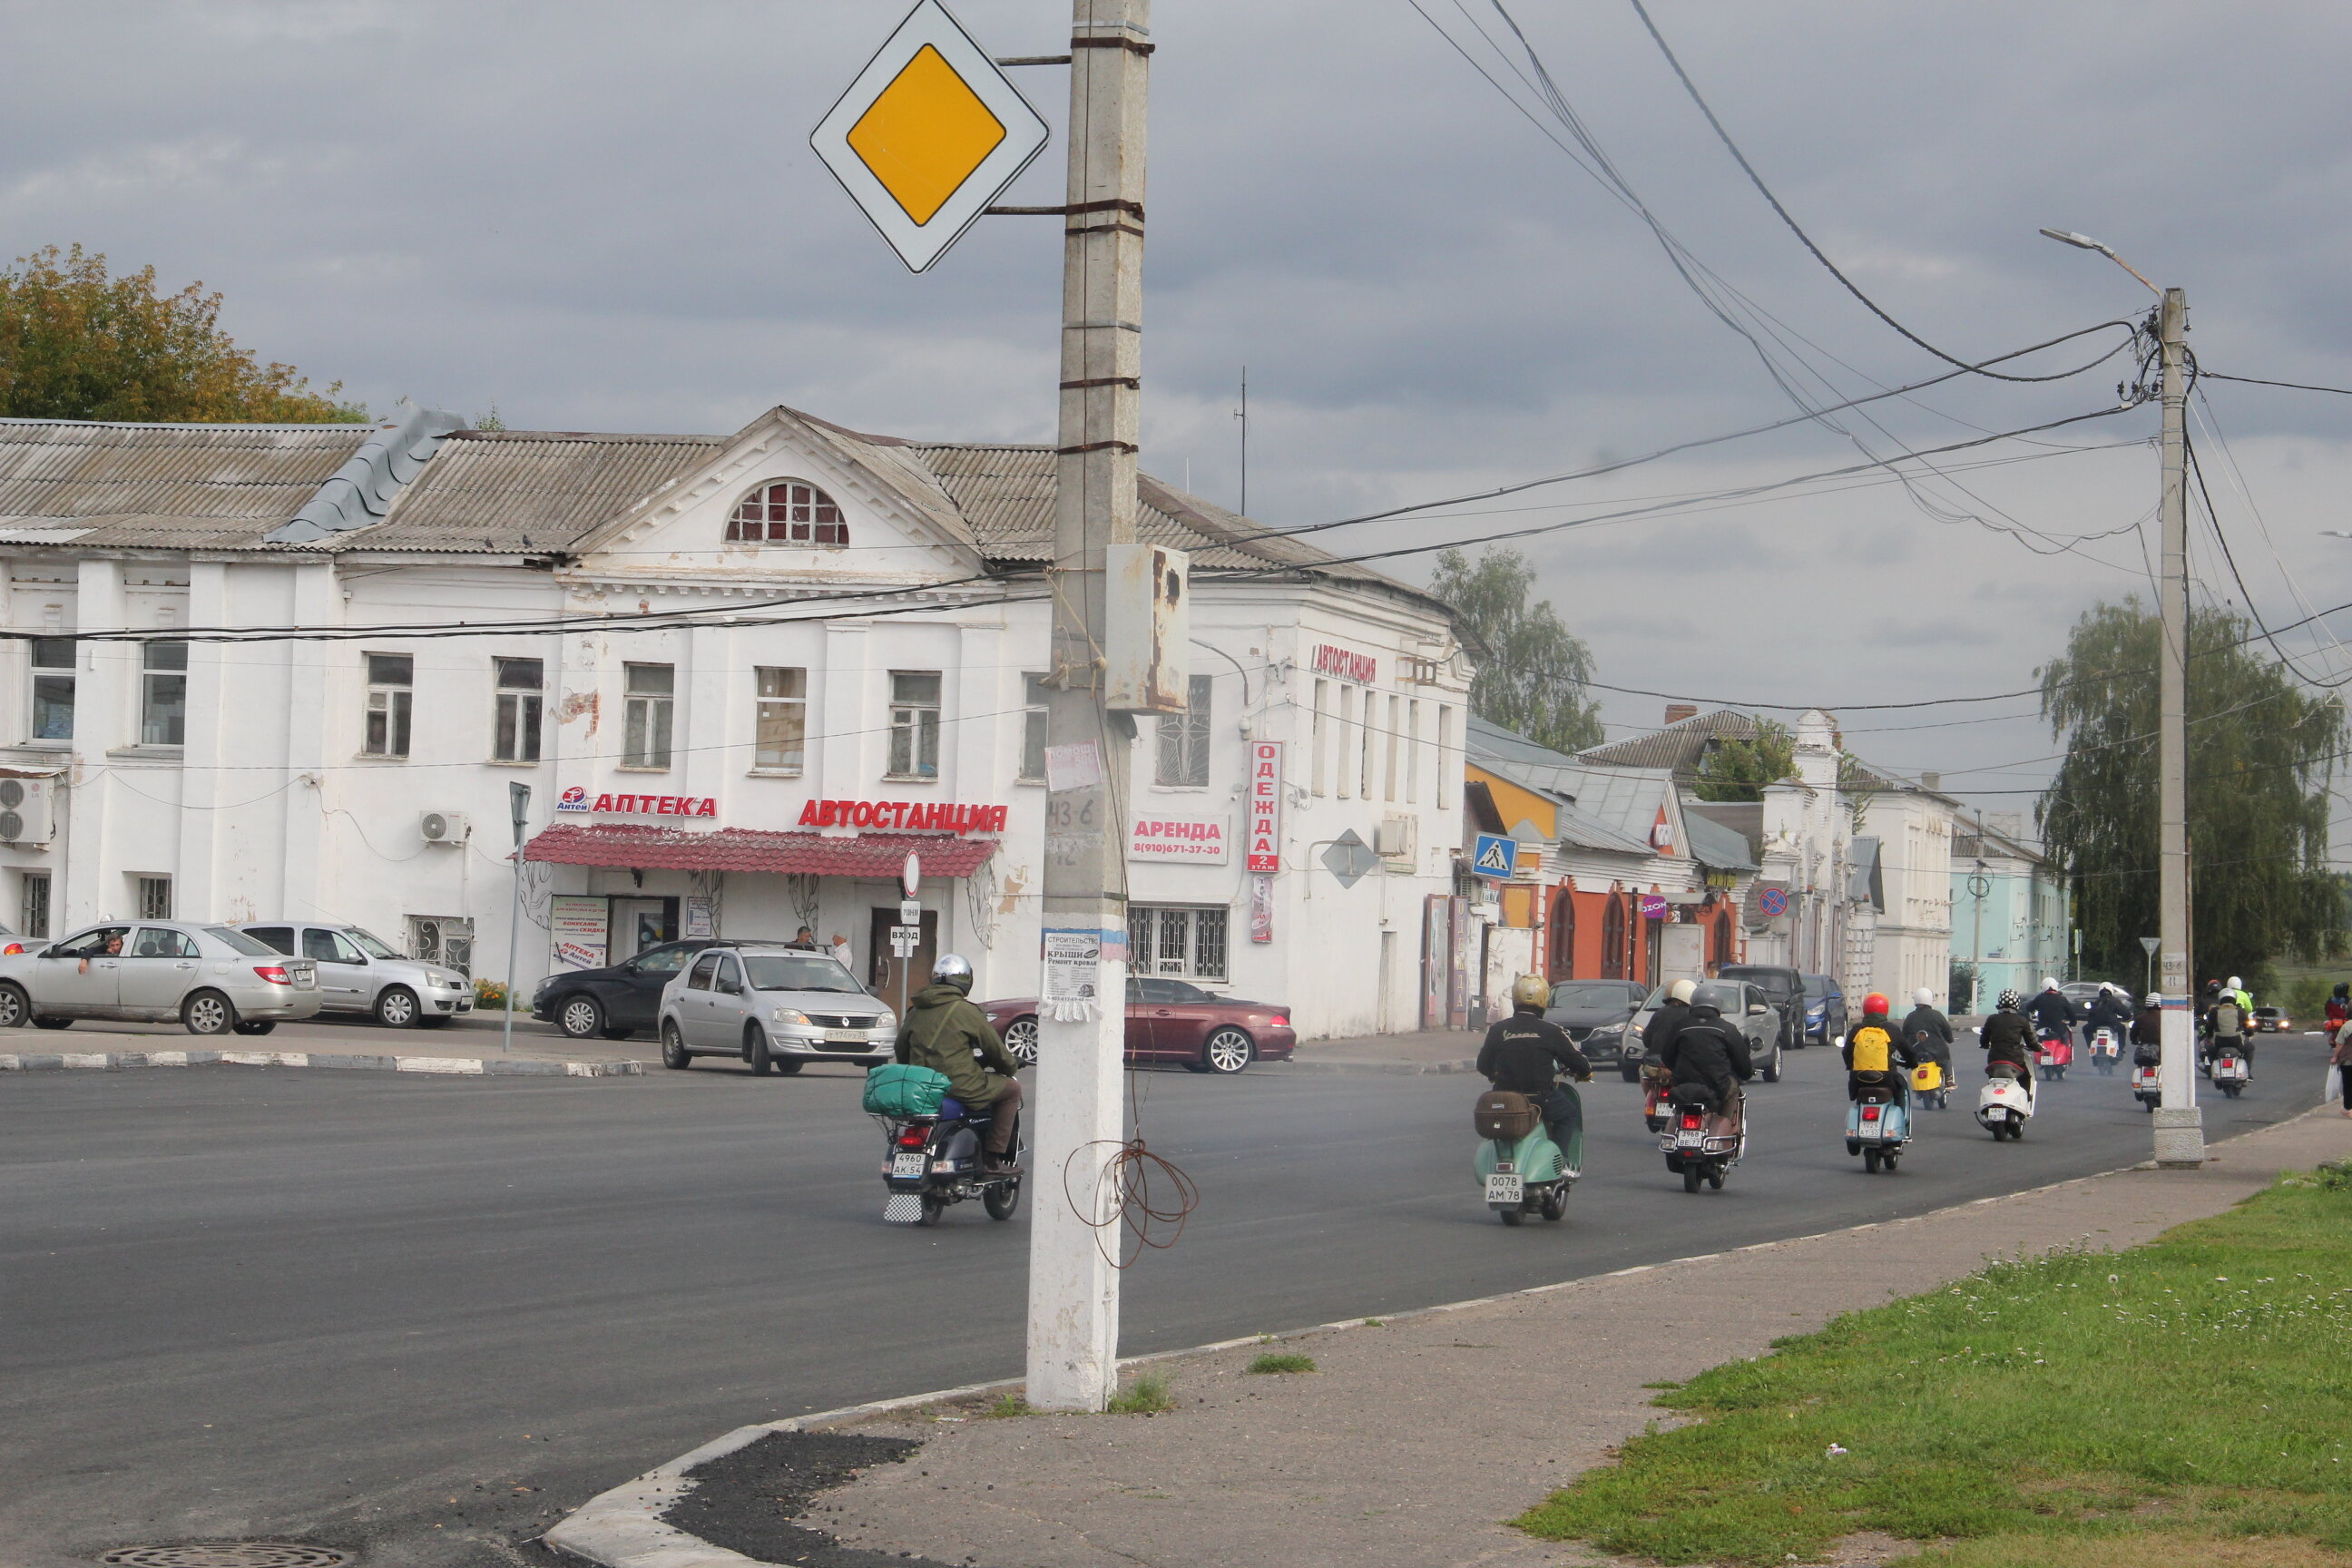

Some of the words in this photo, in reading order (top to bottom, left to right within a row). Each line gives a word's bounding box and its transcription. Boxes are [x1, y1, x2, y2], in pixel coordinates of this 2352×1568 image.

[1317, 643, 1377, 683] АВТОСТАНЦИЯ
[1254, 745, 1276, 852] ОДЕЖДА
[556, 802, 588, 811] Антей
[592, 794, 717, 817] АПТЕКА
[798, 799, 1009, 836] АВТОСТАНЦИЯ
[1133, 820, 1221, 841] АРЕНДА
[1133, 843, 1220, 854] 8(910)671-37-30
[1259, 856, 1268, 865] 2
[1047, 936, 1098, 945] СТРОИТЕЛЬСТВО
[563, 942, 595, 958] АПТЕКА
[1047, 950, 1083, 958] КРЫШИ
[1492, 1177, 1517, 1186] 0078
[1488, 1191, 1504, 1200] АМ
[1507, 1191, 1519, 1200] 78
